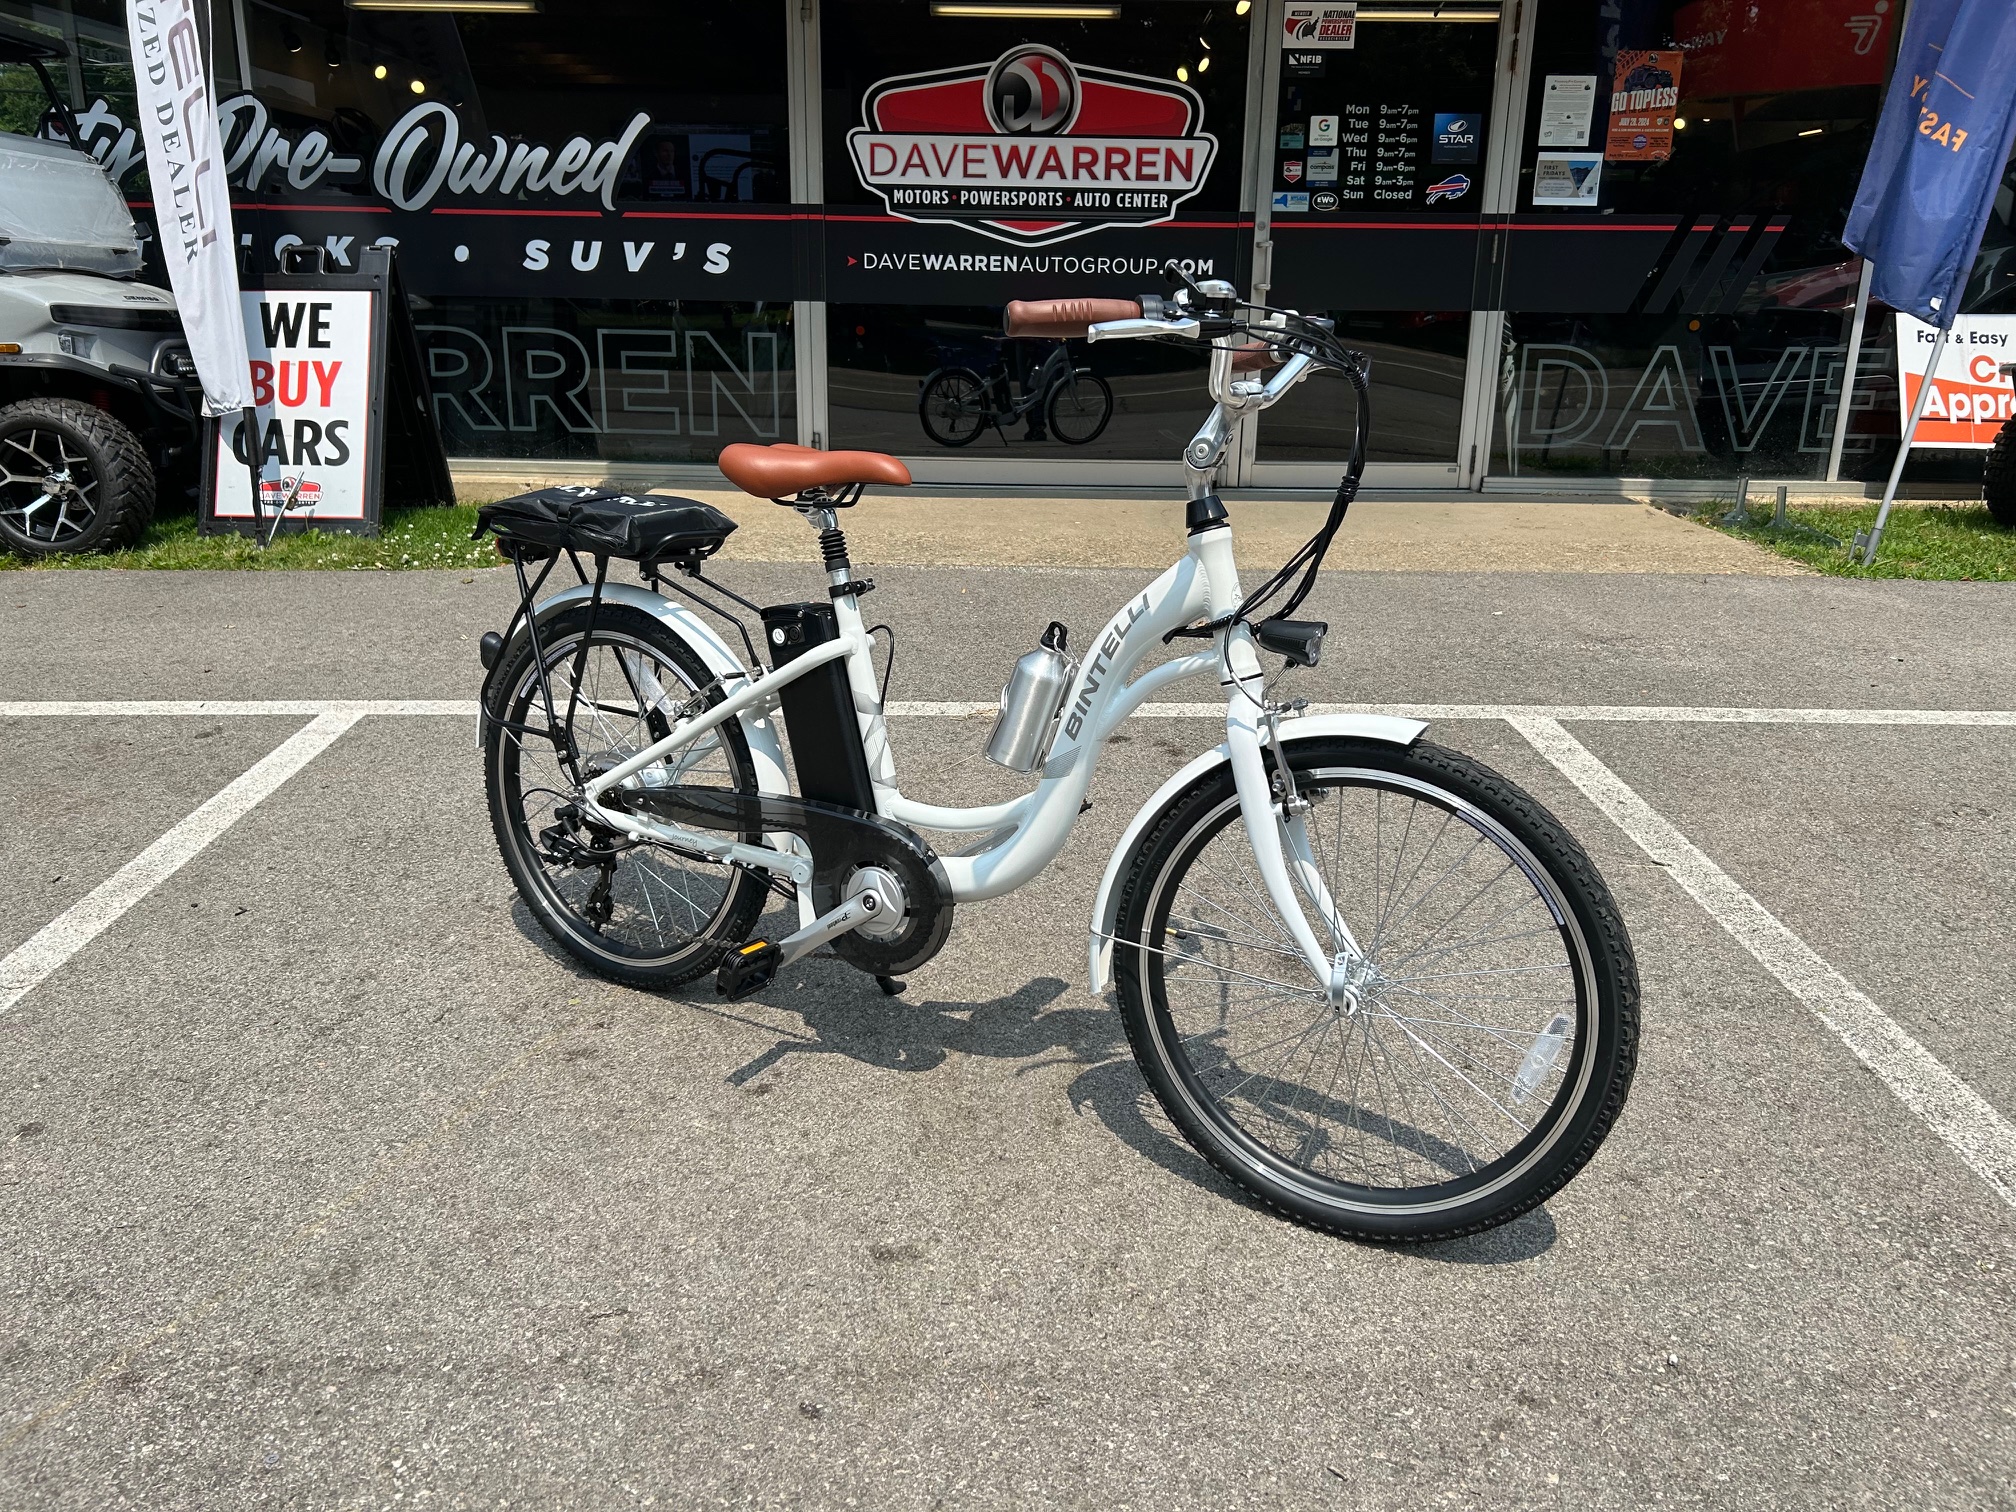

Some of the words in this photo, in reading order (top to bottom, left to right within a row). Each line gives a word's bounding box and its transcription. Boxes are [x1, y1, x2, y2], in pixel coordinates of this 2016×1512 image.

[1323, 10, 1355, 18] NATIONAL
[1319, 25, 1352, 35] DEALER
[1300, 55, 1322, 64] NFIB
[1611, 92, 1627, 112] GO
[1630, 86, 1678, 110] TOPLESS
[1345, 104, 1370, 114] Mon
[1380, 105, 1419, 115] 9am-7pm
[160, 0, 218, 248] ELLI
[1348, 119, 1369, 128] Tue
[1379, 119, 1418, 129] 9am-7pm
[1619, 117, 1630, 126] JULY
[1638, 117, 1649, 126] 2024
[1342, 133, 1368, 143] Wed
[1378, 133, 1418, 144] 9am-6pm
[1438, 134, 1474, 144] STAR
[1345, 147, 1367, 157] Thu
[1377, 147, 1416, 158] 9am-7pm
[868, 141, 1194, 183] DAVEWARREN
[1350, 161, 1366, 171] Fri
[1376, 161, 1416, 172] 9am-6pm
[155, 101, 199, 265] DEALER
[1347, 175, 1365, 185] Sat
[1375, 176, 1414, 186] 9am-3pm
[893, 189, 949, 205] MOTORS
[960, 191, 1063, 206] POWERSPORTS
[1074, 192, 1111, 208] AUTO
[1116, 193, 1168, 208] CENTER
[1343, 189, 1364, 199] Sun
[1373, 189, 1412, 199] Closed
[259, 302, 333, 349] WE
[1917, 330, 1950, 344] Fat
[1955, 334, 1964, 344] &
[1970, 331, 2009, 347] Easy
[249, 360, 343, 408] BUY
[414, 325, 780, 438] RREN
[1513, 343, 1891, 455] DAVE
[232, 418, 350, 467] CARS
[260, 492, 321, 500] AVEWRREN
[1064, 593, 1150, 741] BINTELLI
